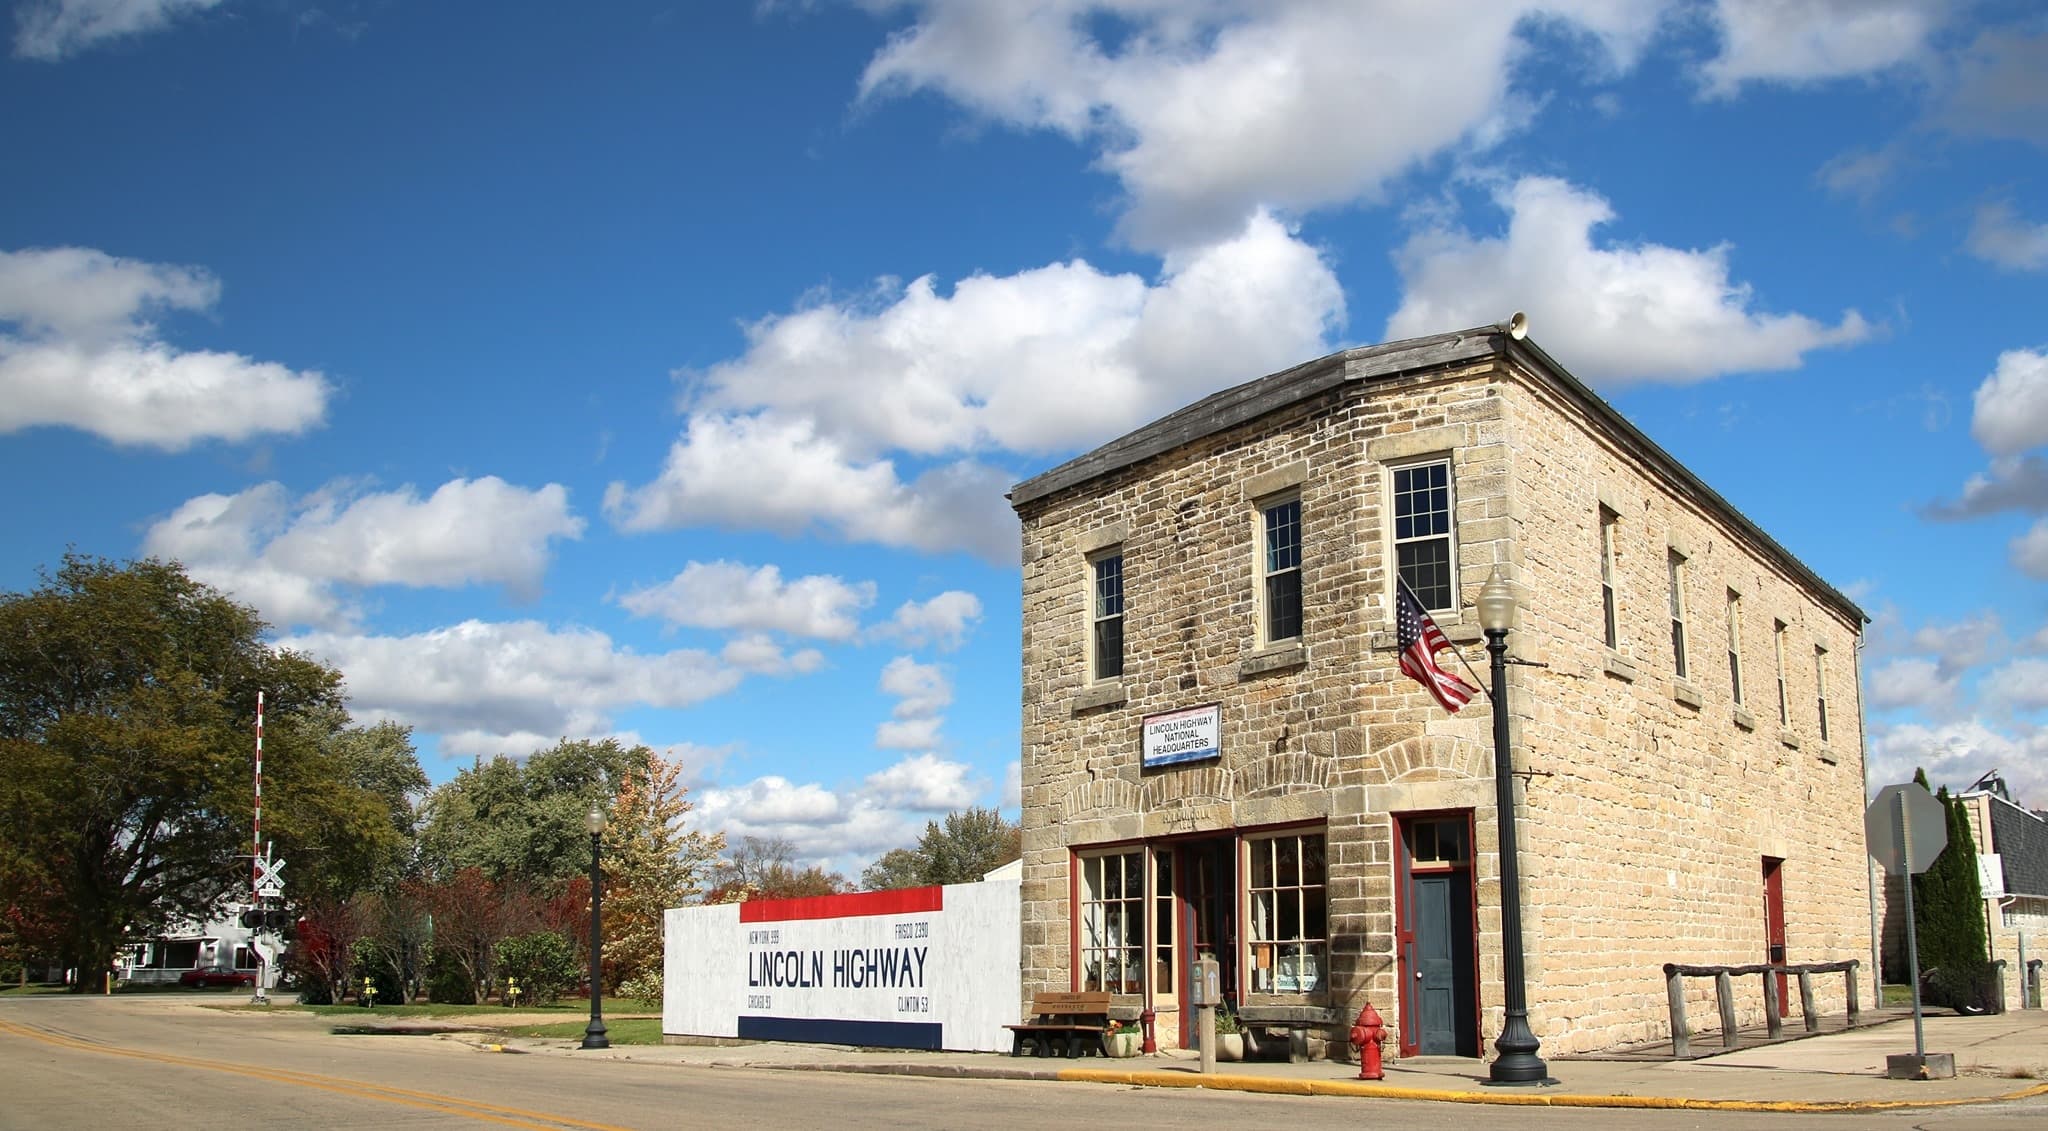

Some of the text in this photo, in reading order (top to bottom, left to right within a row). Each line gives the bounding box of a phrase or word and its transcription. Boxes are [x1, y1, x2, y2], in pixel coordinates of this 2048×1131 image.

[1149, 716, 1213, 736] LINCOLN HIGHWAY
[1164, 729, 1199, 743] NATIONAL
[1153, 738, 1209, 755] HEADQUARTERS
[749, 930, 758, 944] NEW
[759, 930, 769, 944] YORK
[895, 922, 928, 939] FRISCO 2390
[749, 946, 928, 988] LINCOLN HIGHWAY
[898, 996, 928, 1012] CLINTON 53
